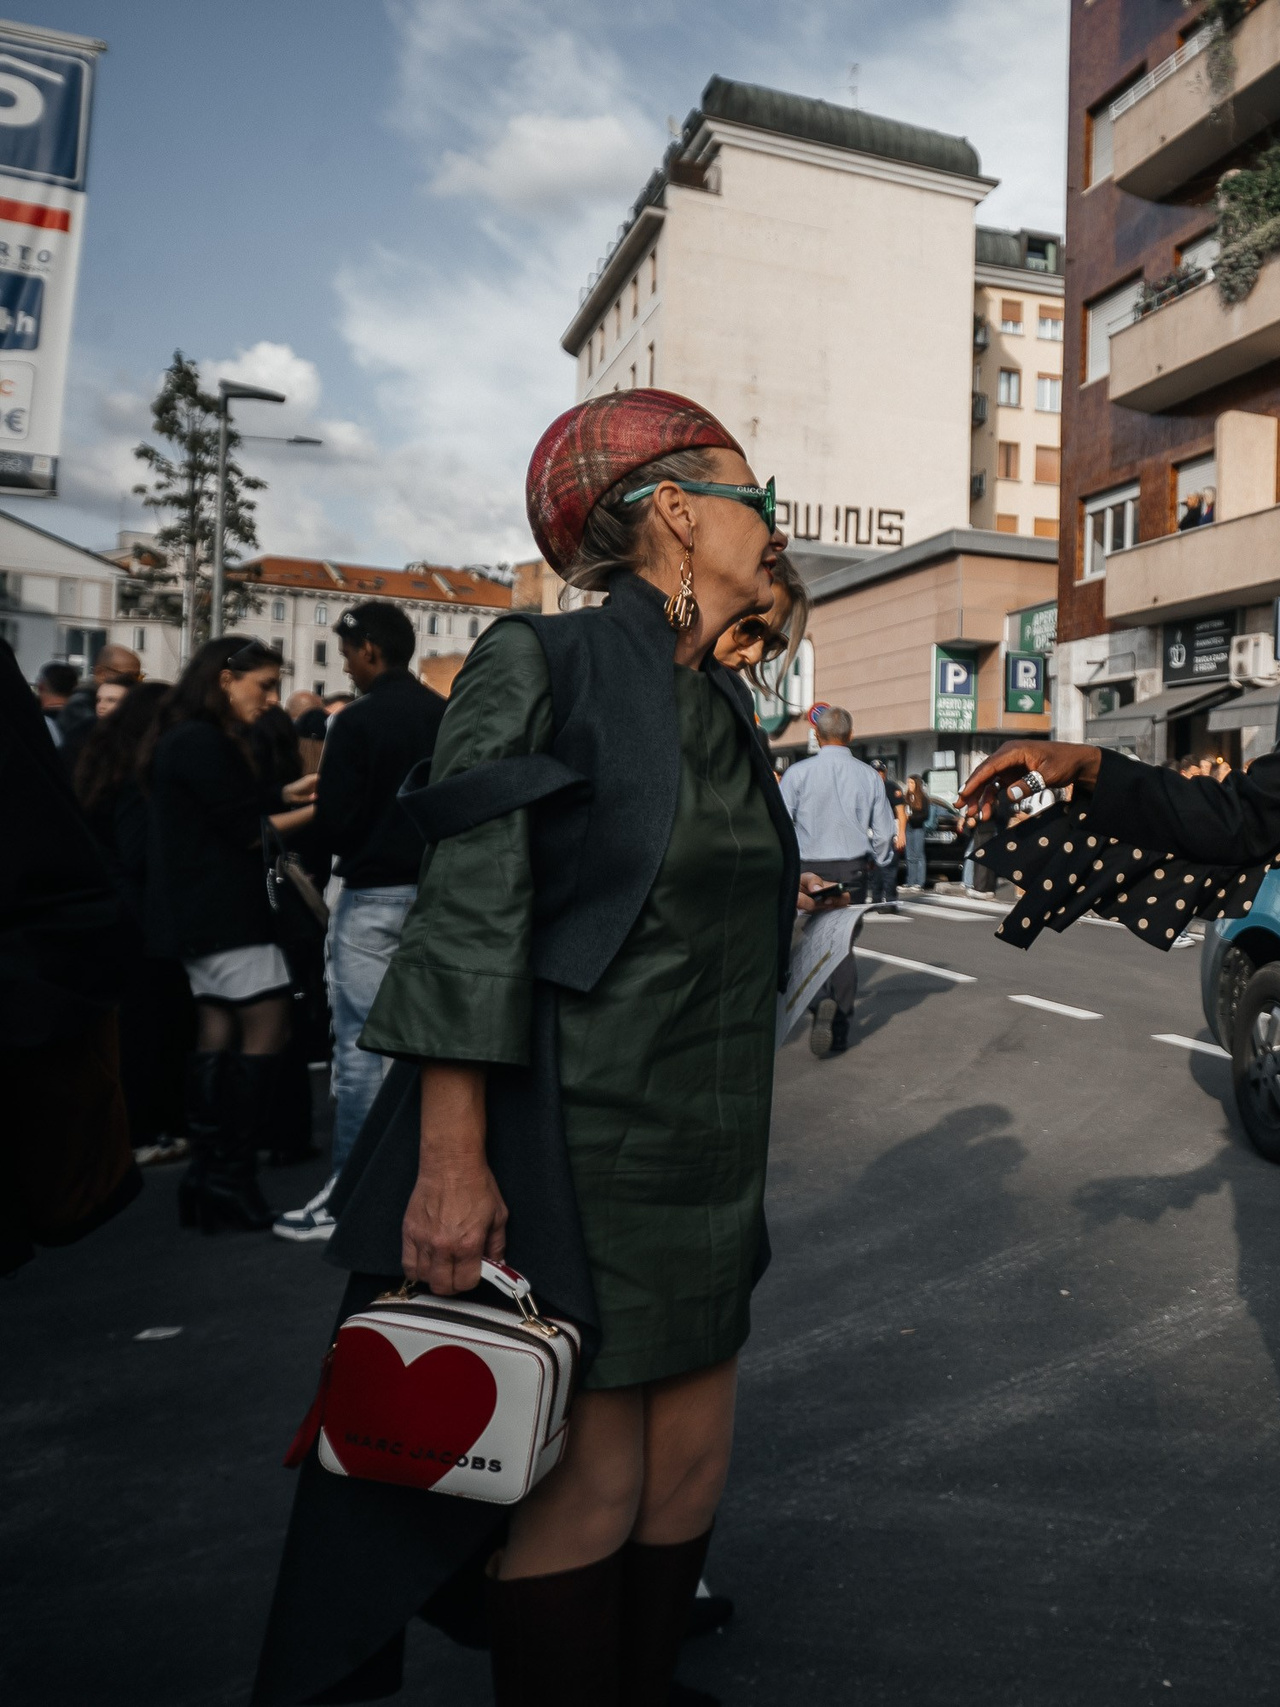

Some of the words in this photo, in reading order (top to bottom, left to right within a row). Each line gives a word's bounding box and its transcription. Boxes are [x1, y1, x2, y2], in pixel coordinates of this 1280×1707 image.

[946, 663, 968, 693] P
[1017, 660, 1037, 689] P
[345, 1433, 403, 1455] MARC
[410, 1446, 502, 1473] JACOBS
